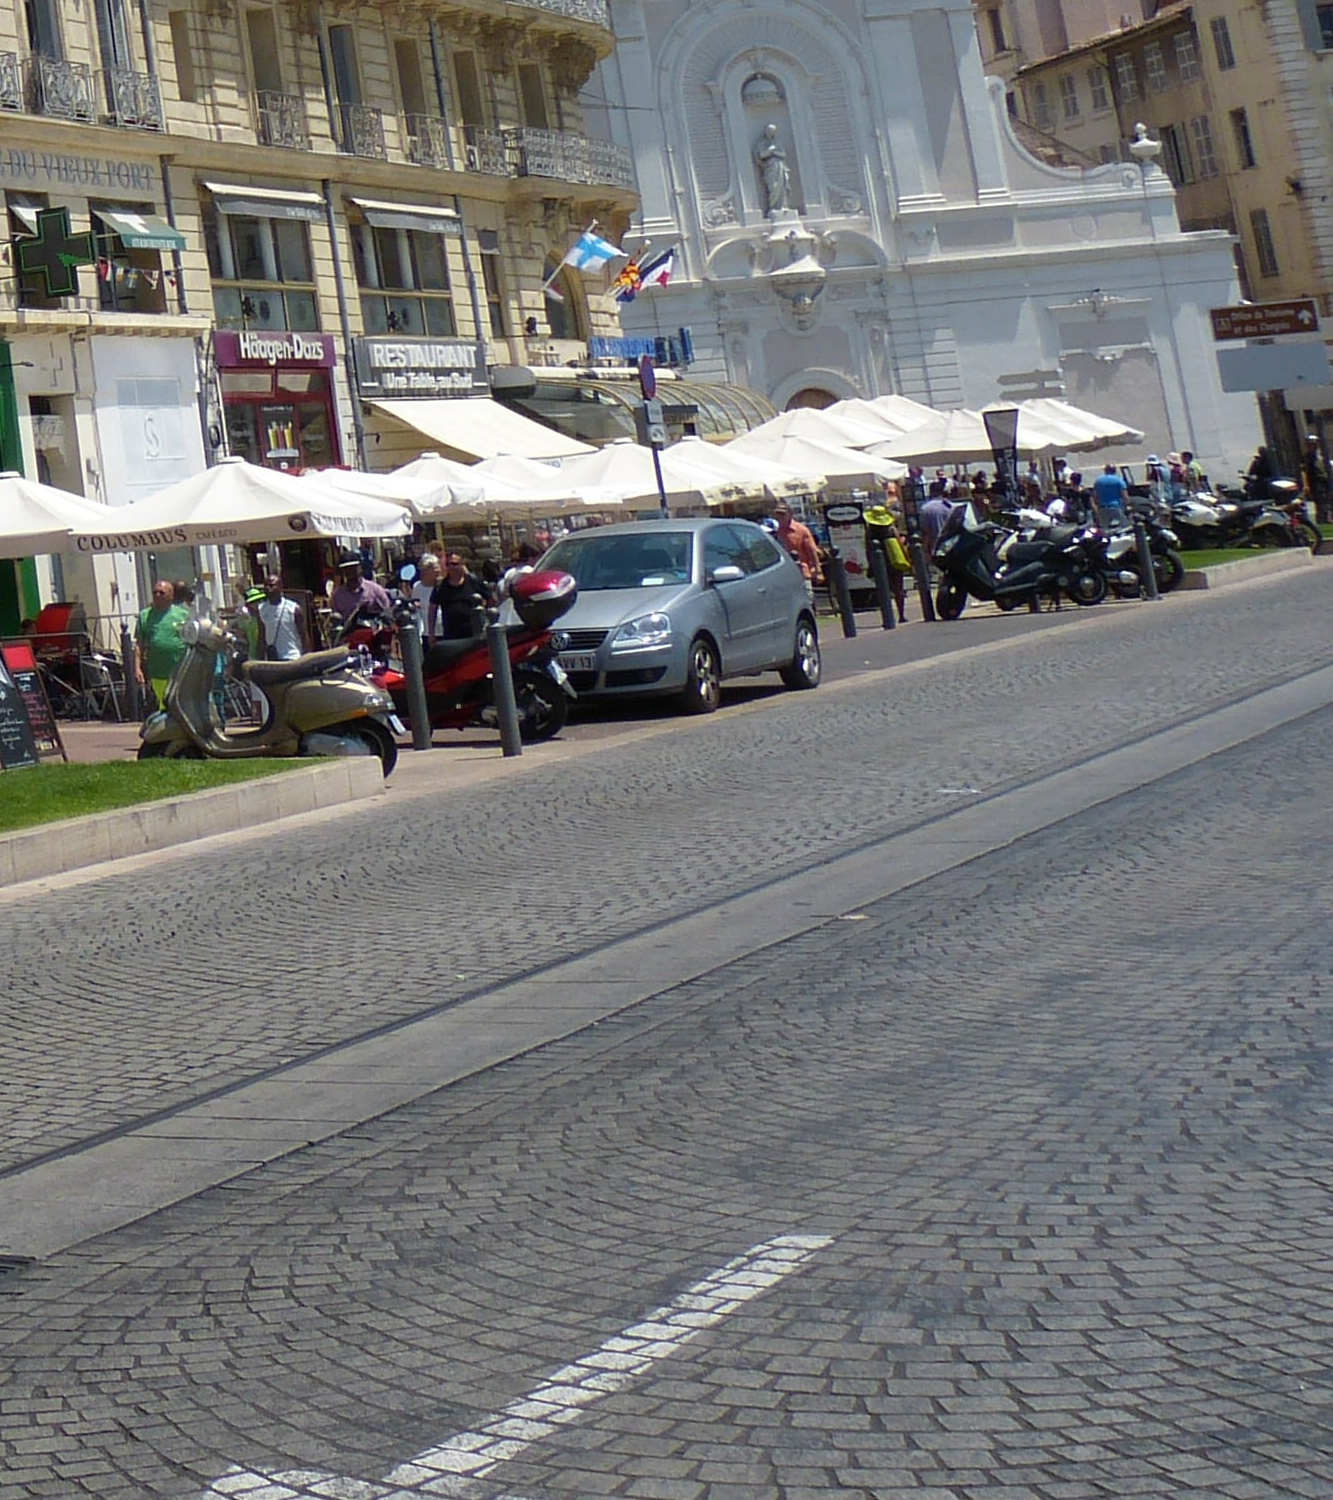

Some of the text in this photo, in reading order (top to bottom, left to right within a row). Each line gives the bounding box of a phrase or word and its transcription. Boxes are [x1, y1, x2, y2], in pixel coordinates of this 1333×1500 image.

[8, 148, 37, 181] DU
[40, 152, 104, 187] VIEUX
[106, 160, 155, 191] PORT
[371, 343, 477, 368] RESTAURANT
[76, 528, 188, 551] COLUMBUS
